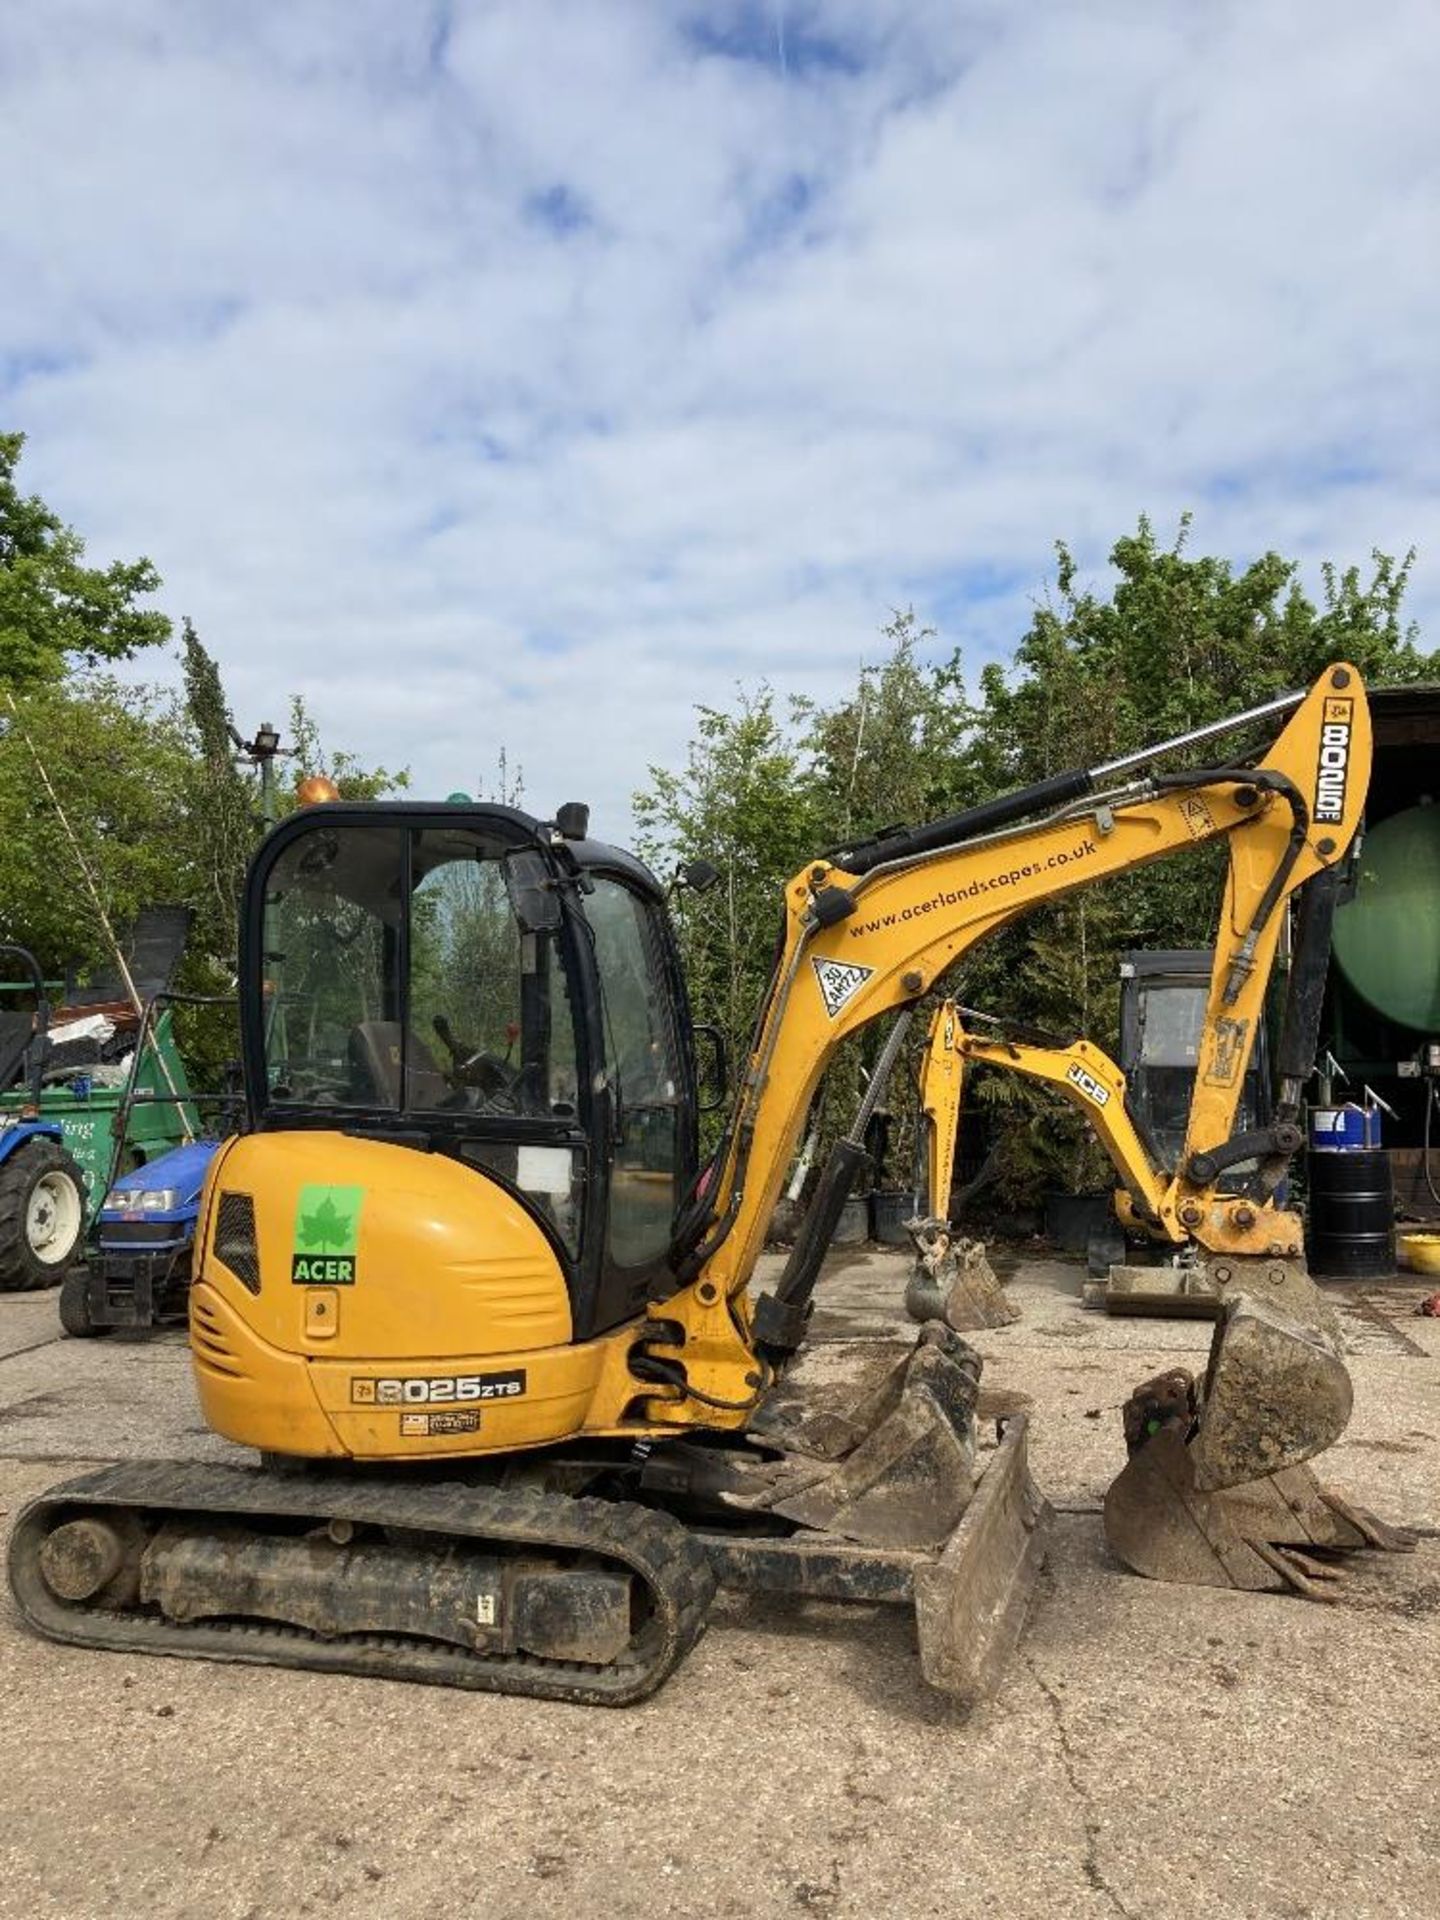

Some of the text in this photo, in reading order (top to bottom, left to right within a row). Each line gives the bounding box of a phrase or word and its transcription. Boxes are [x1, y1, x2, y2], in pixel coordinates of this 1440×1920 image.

[1316, 724, 1349, 811] 8025
[850, 840, 1097, 937] www.acerlandscapes.co.uk
[1066, 1064, 1110, 1106] JCB
[293, 1260, 353, 1280] ACER
